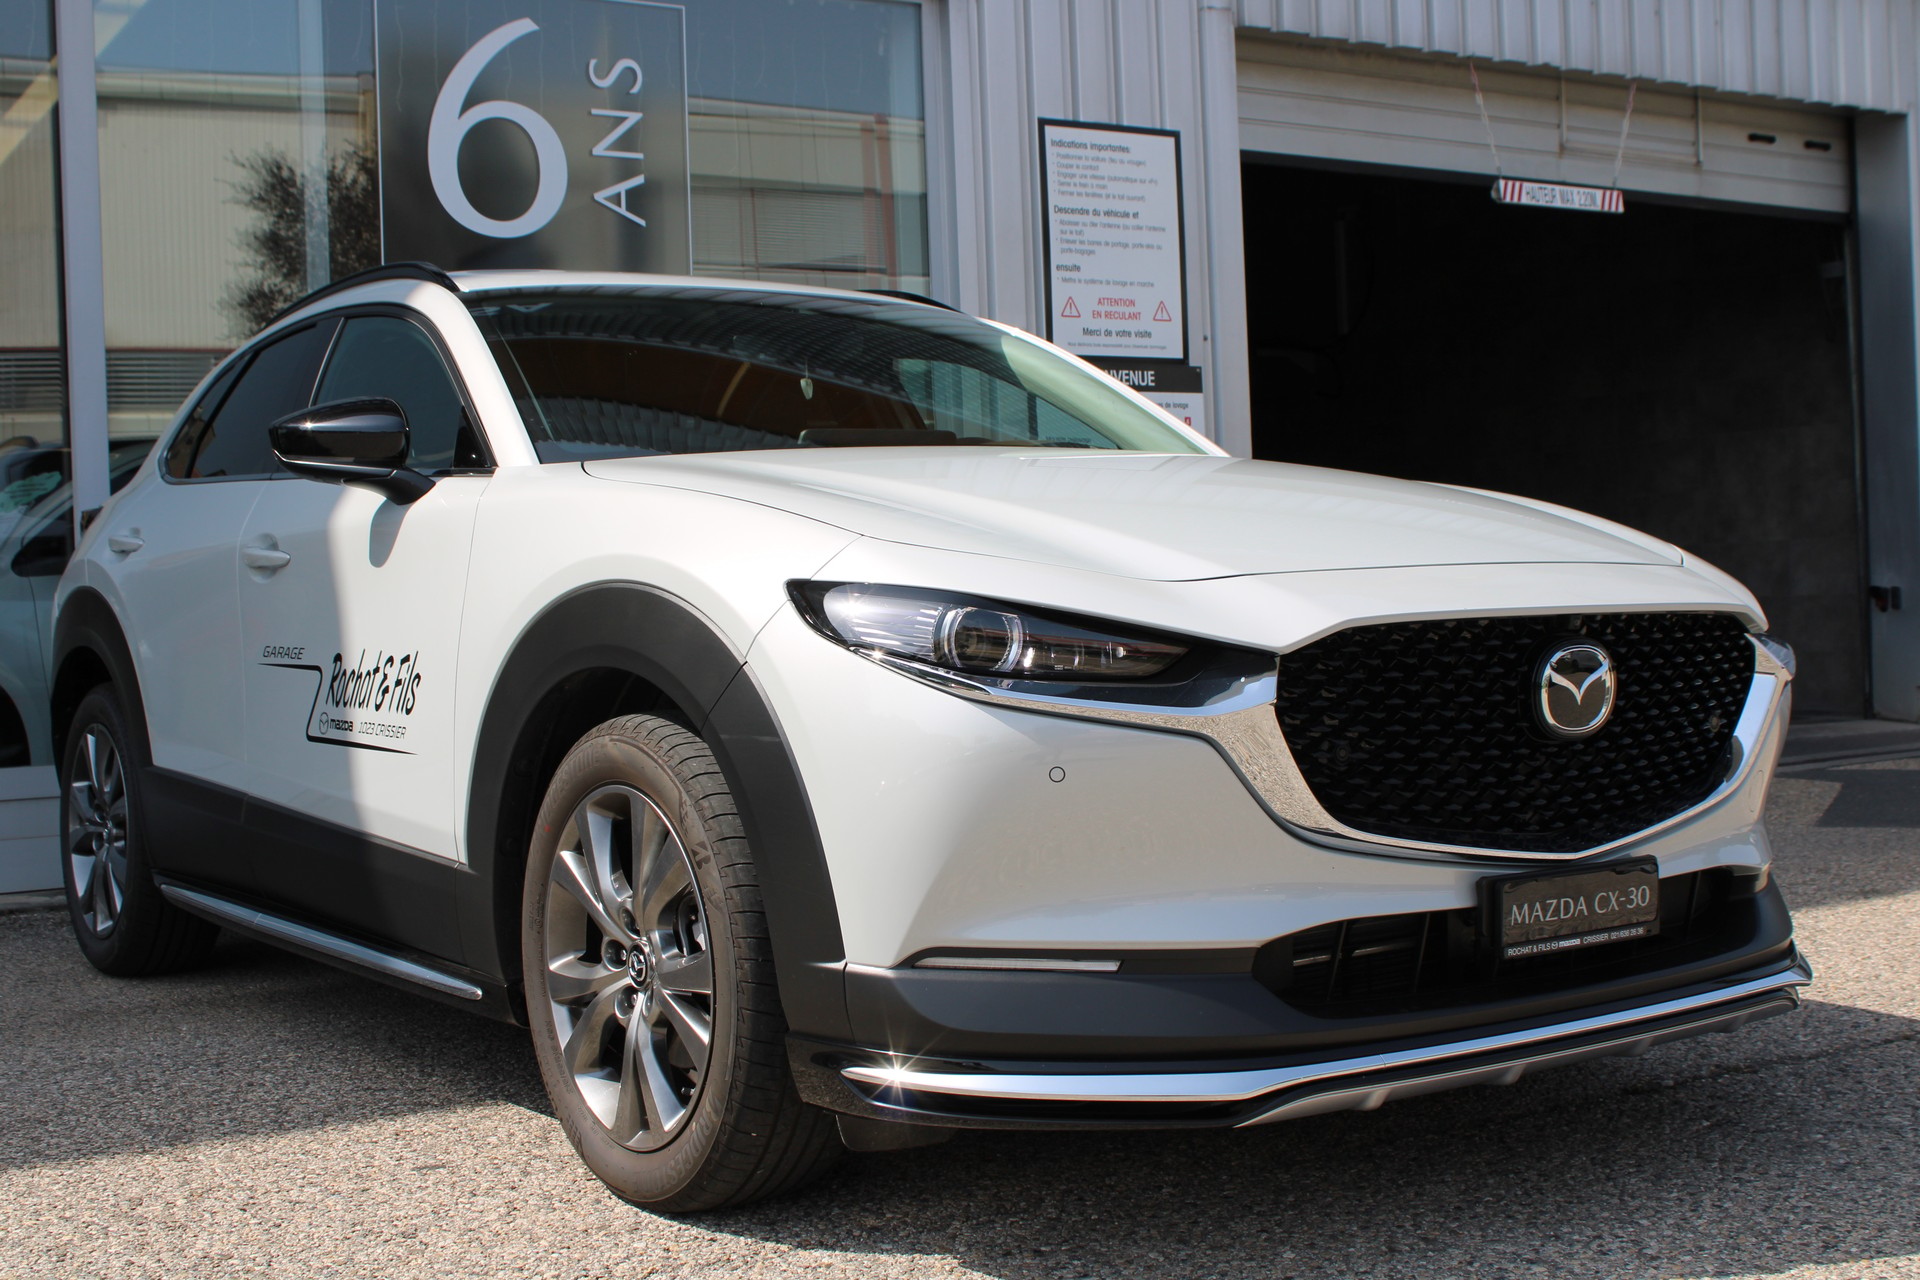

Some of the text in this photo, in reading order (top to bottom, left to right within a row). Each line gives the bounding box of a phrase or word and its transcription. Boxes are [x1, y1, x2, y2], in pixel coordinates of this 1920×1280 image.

[427, 16, 568, 239] 6
[589, 57, 646, 228] ANS
[1051, 138, 1131, 153] Indications importantes:
[1525, 184, 1557, 204] HAUTEUR
[1559, 188, 1575, 205] MAX
[1054, 205, 1139, 219] Descendre du véhicule et
[1056, 263, 1081, 272] ensuite
[1097, 297, 1136, 308] ATTENTION
[1092, 310, 1142, 321] EN RECULANT
[1082, 327, 1152, 339] Merci de votre visite
[263, 645, 305, 660] GARAGE
[326, 648, 422, 716] Rochat & Fils
[330, 718, 407, 740] mazda 1023 CRISSIER
[1511, 885, 1650, 926] MAZDA CX-30
[1507, 945, 1532, 957] ROCHAT
[1538, 942, 1551, 952] FILS
[1583, 933, 1609, 944] CRISSIER
